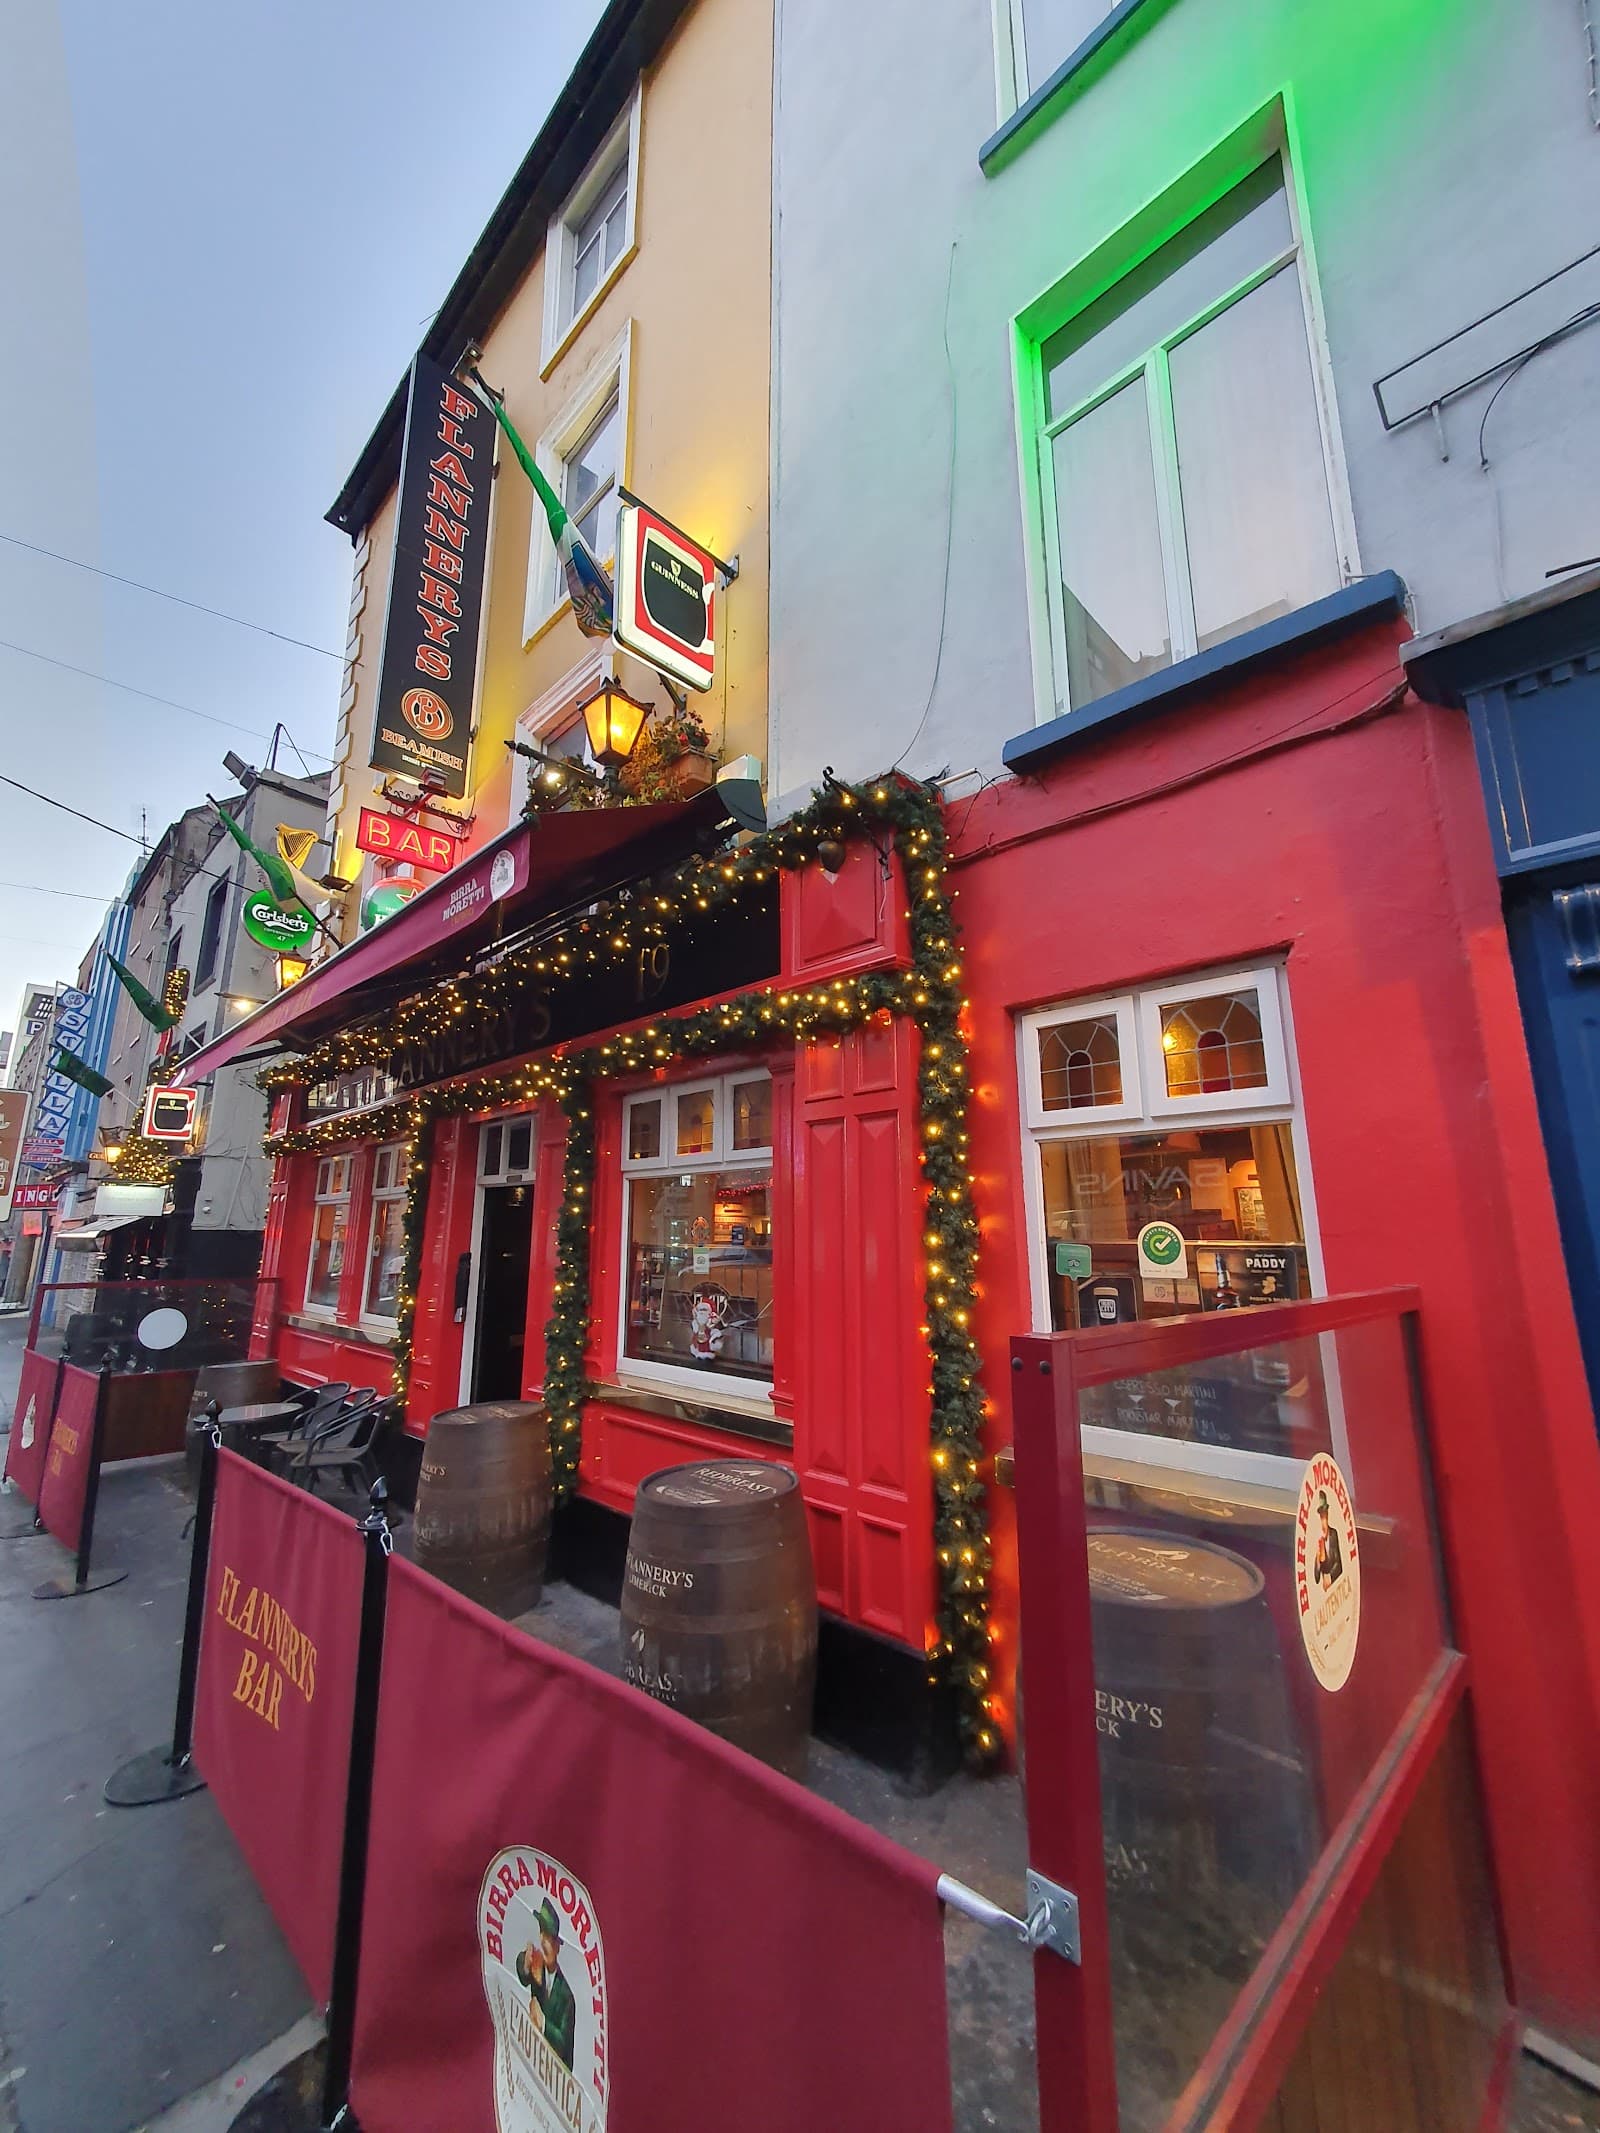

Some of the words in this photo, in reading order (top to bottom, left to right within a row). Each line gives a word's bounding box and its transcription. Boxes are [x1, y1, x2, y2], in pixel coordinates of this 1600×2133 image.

[415, 382, 478, 681] FLANNERYS
[650, 560, 699, 600] GUINNESS
[381, 727, 464, 771] BEAMISH
[368, 814, 451, 865] BAR
[442, 885, 486, 921] MORETTI
[450, 877, 478, 905] BIRRA
[252, 903, 309, 932] Carlsberg
[1245, 1258, 1286, 1269] PADDY
[1296, 1481, 1314, 1616] BIRRA
[1312, 1459, 1356, 1561] MORETTI
[217, 1566, 318, 1702] FLANNERYS
[233, 1648, 284, 1731] BAR
[486, 1857, 535, 1964] BIRRA
[535, 1857, 605, 2106] MORETTI
[509, 1998, 584, 2130] L'AUTENTICA
